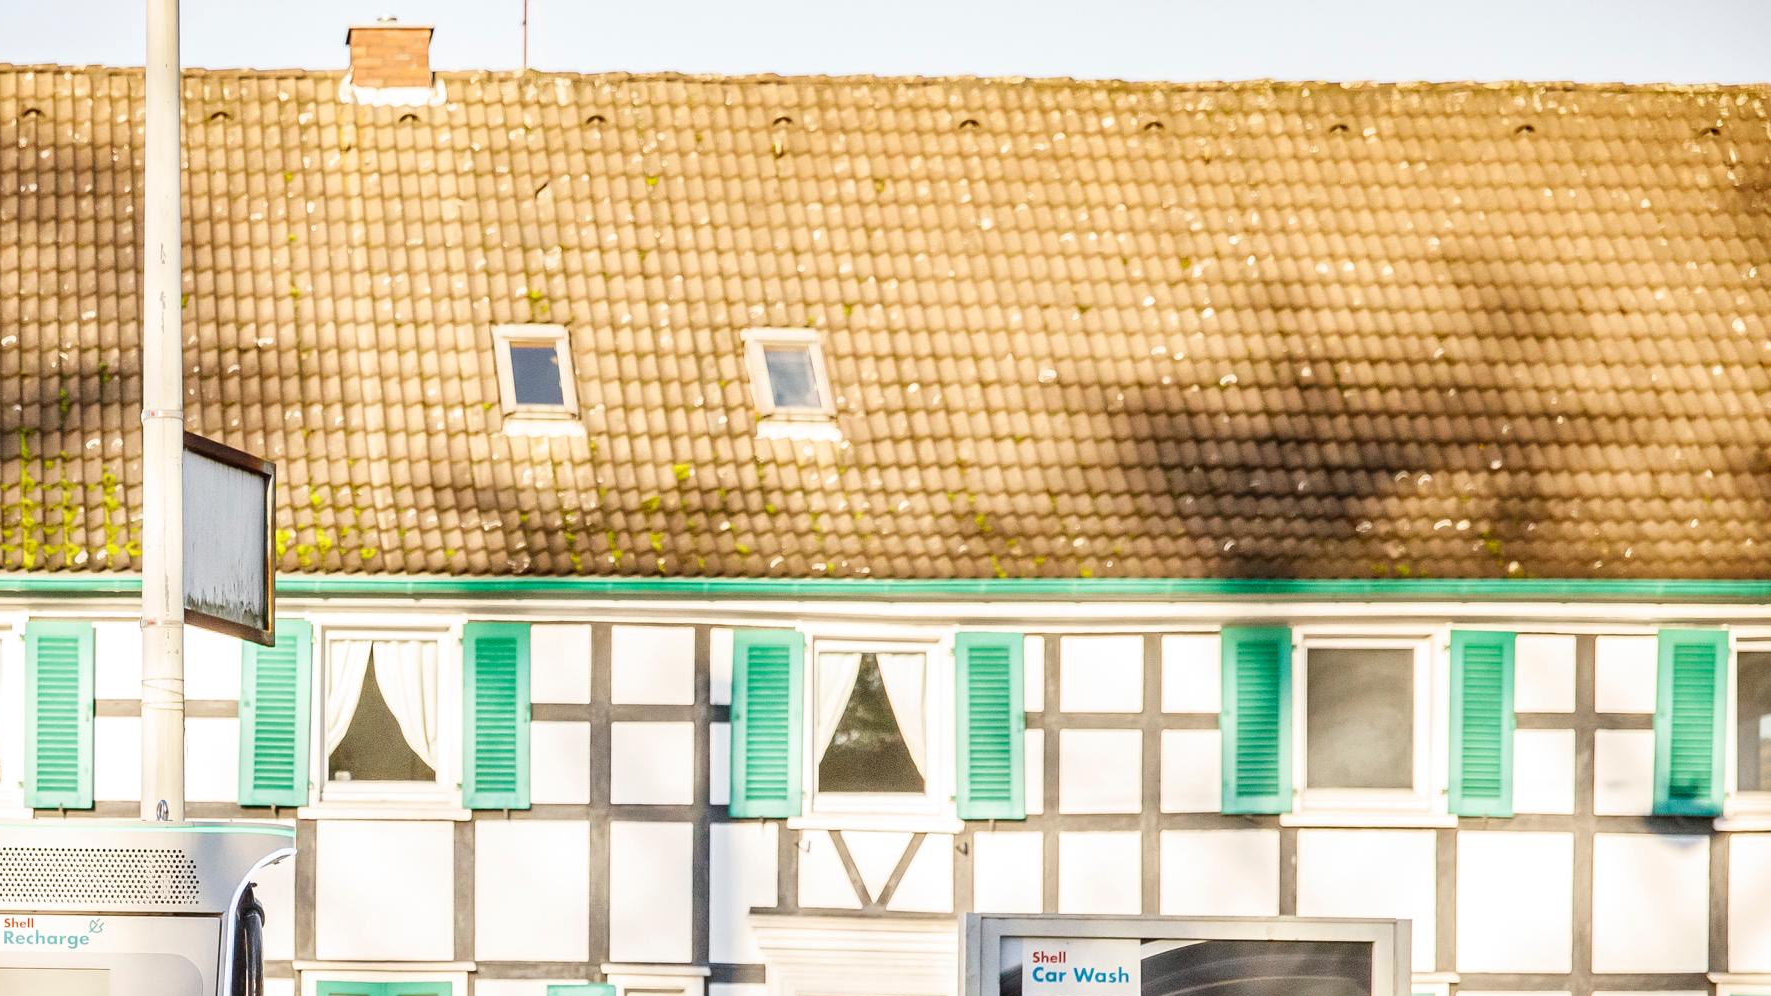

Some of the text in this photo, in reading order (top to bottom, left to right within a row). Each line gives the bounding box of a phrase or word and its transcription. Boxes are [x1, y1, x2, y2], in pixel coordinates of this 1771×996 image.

[3, 917, 35, 929] Shell
[3, 929, 90, 949] Recharge
[1032, 951, 1067, 964] Shell
[1032, 966, 1130, 984] Car Wash
